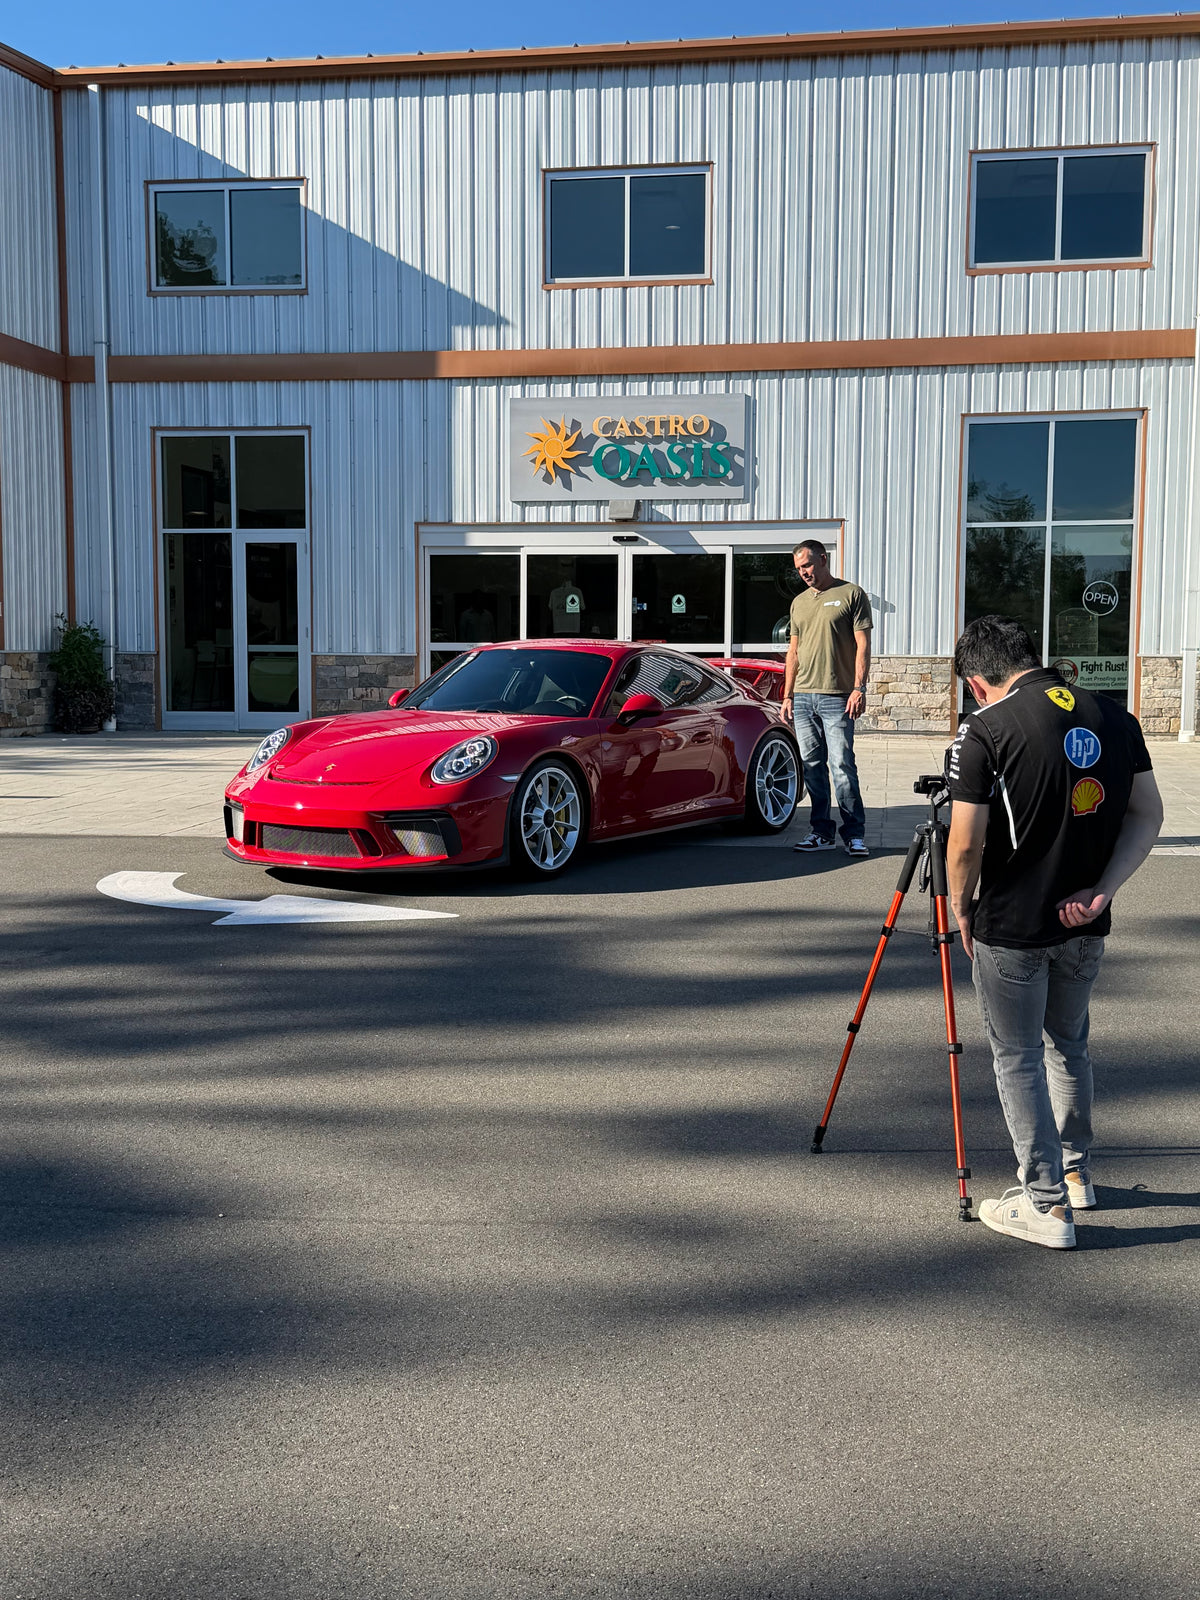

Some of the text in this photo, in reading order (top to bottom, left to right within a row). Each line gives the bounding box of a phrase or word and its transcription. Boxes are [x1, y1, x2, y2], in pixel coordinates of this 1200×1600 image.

[592, 414, 710, 437] CASTRO
[592, 441, 731, 480] OASIS
[1085, 591, 1116, 606] OPEN
[1080, 661, 1128, 674] Fight Rust!
[1072, 728, 1094, 768] hp
